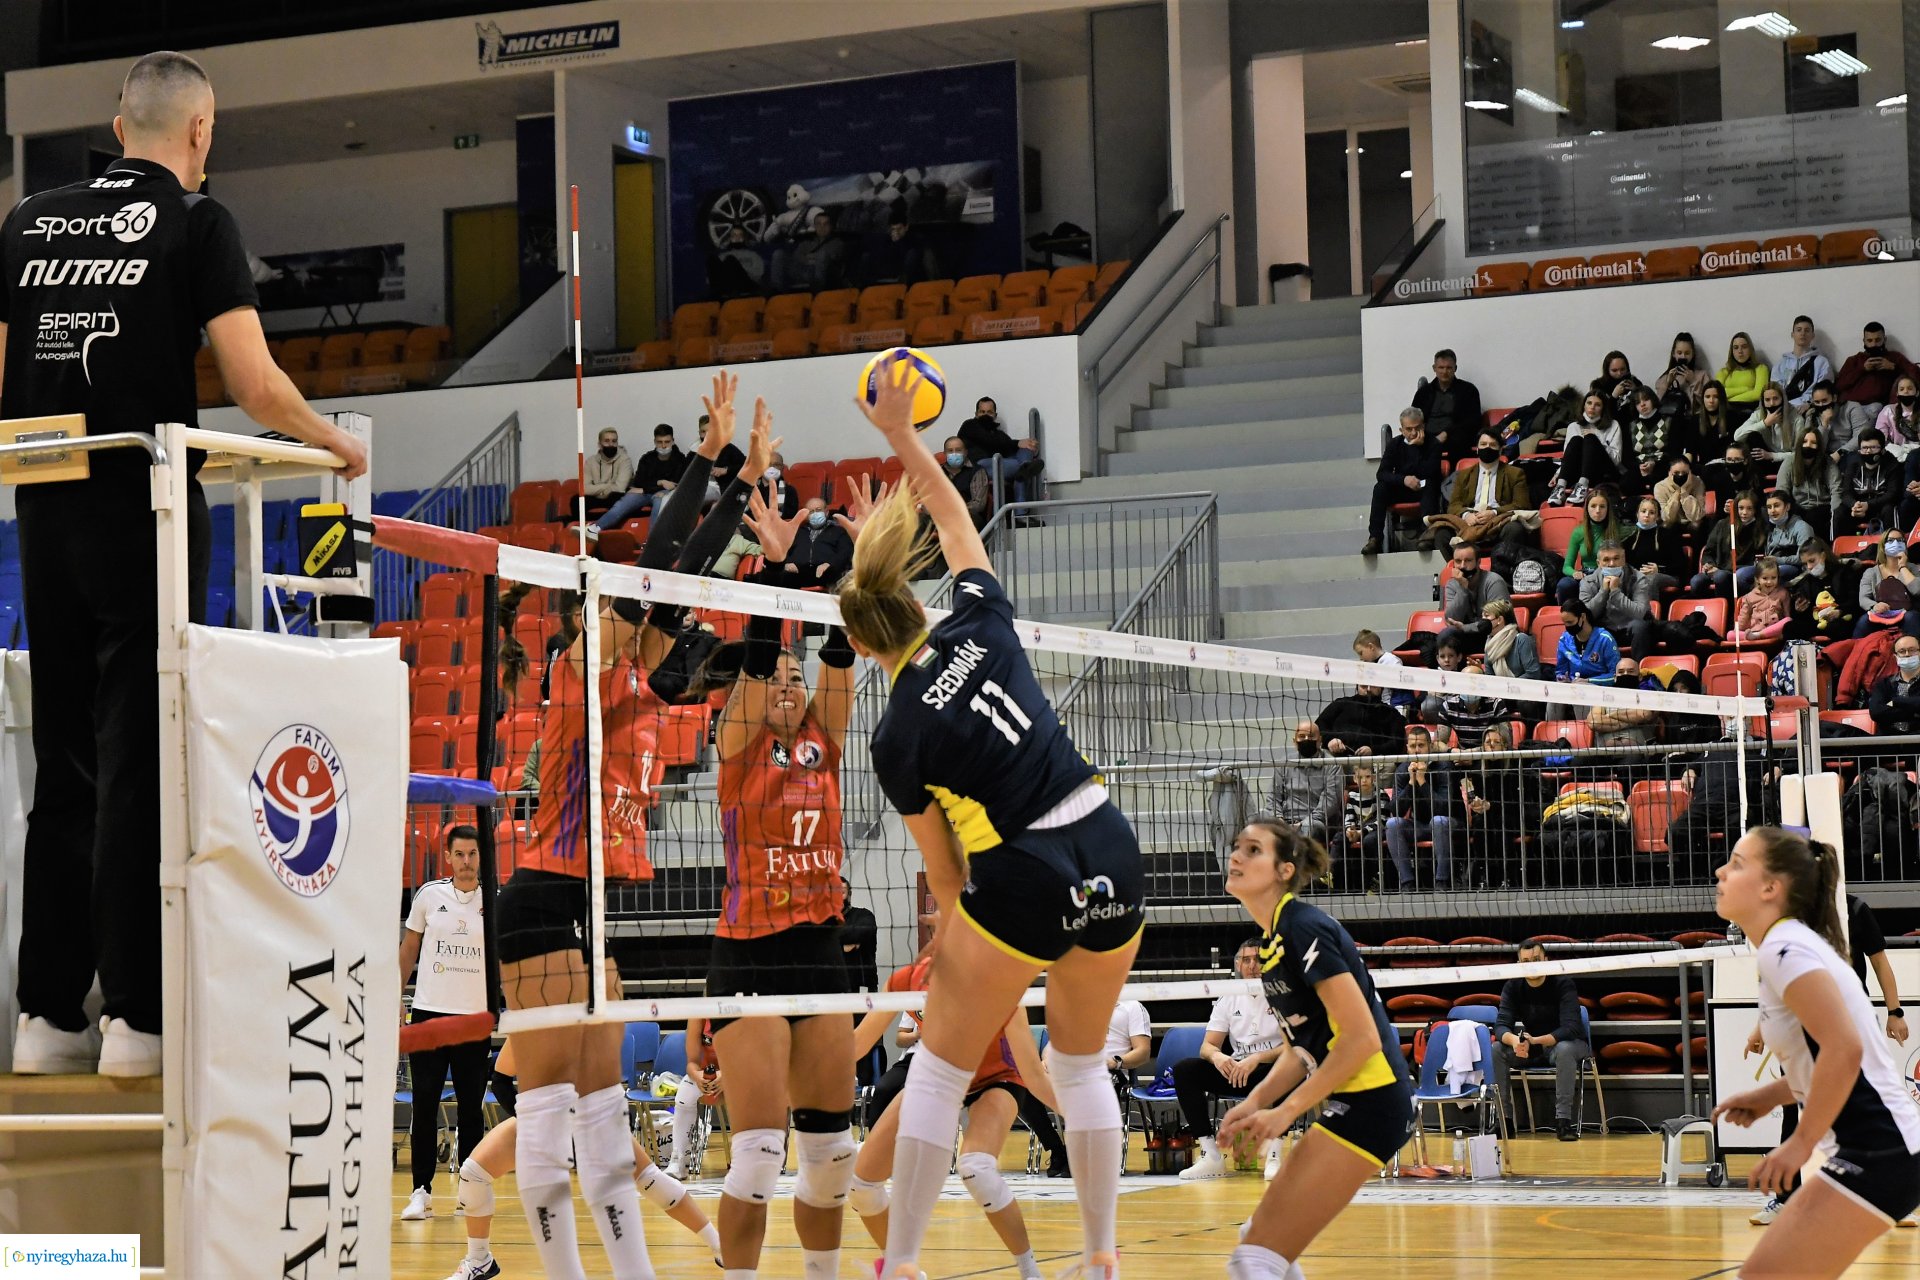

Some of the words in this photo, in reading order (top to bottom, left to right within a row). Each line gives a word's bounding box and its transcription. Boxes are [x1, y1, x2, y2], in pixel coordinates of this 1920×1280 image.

[506, 26, 616, 54] MICHELIN
[89, 177, 135, 188] Zeus
[1394, 273, 1479, 299] Continental
[1544, 260, 1633, 286] Continental
[1701, 244, 1792, 272] Continental
[38, 312, 116, 330] SPIRIT
[36, 330, 69, 341] AUTO
[35, 350, 80, 361] KAPOSVÁR
[776, 594, 803, 612] FATUM
[921, 638, 989, 711] SZEDMÁK
[969, 679, 1033, 747] 11
[295, 728, 340, 777] FATUM
[791, 809, 821, 847] 17
[254, 808, 336, 894] NYÍREGYHÁZA
[436, 940, 481, 956] FATUM
